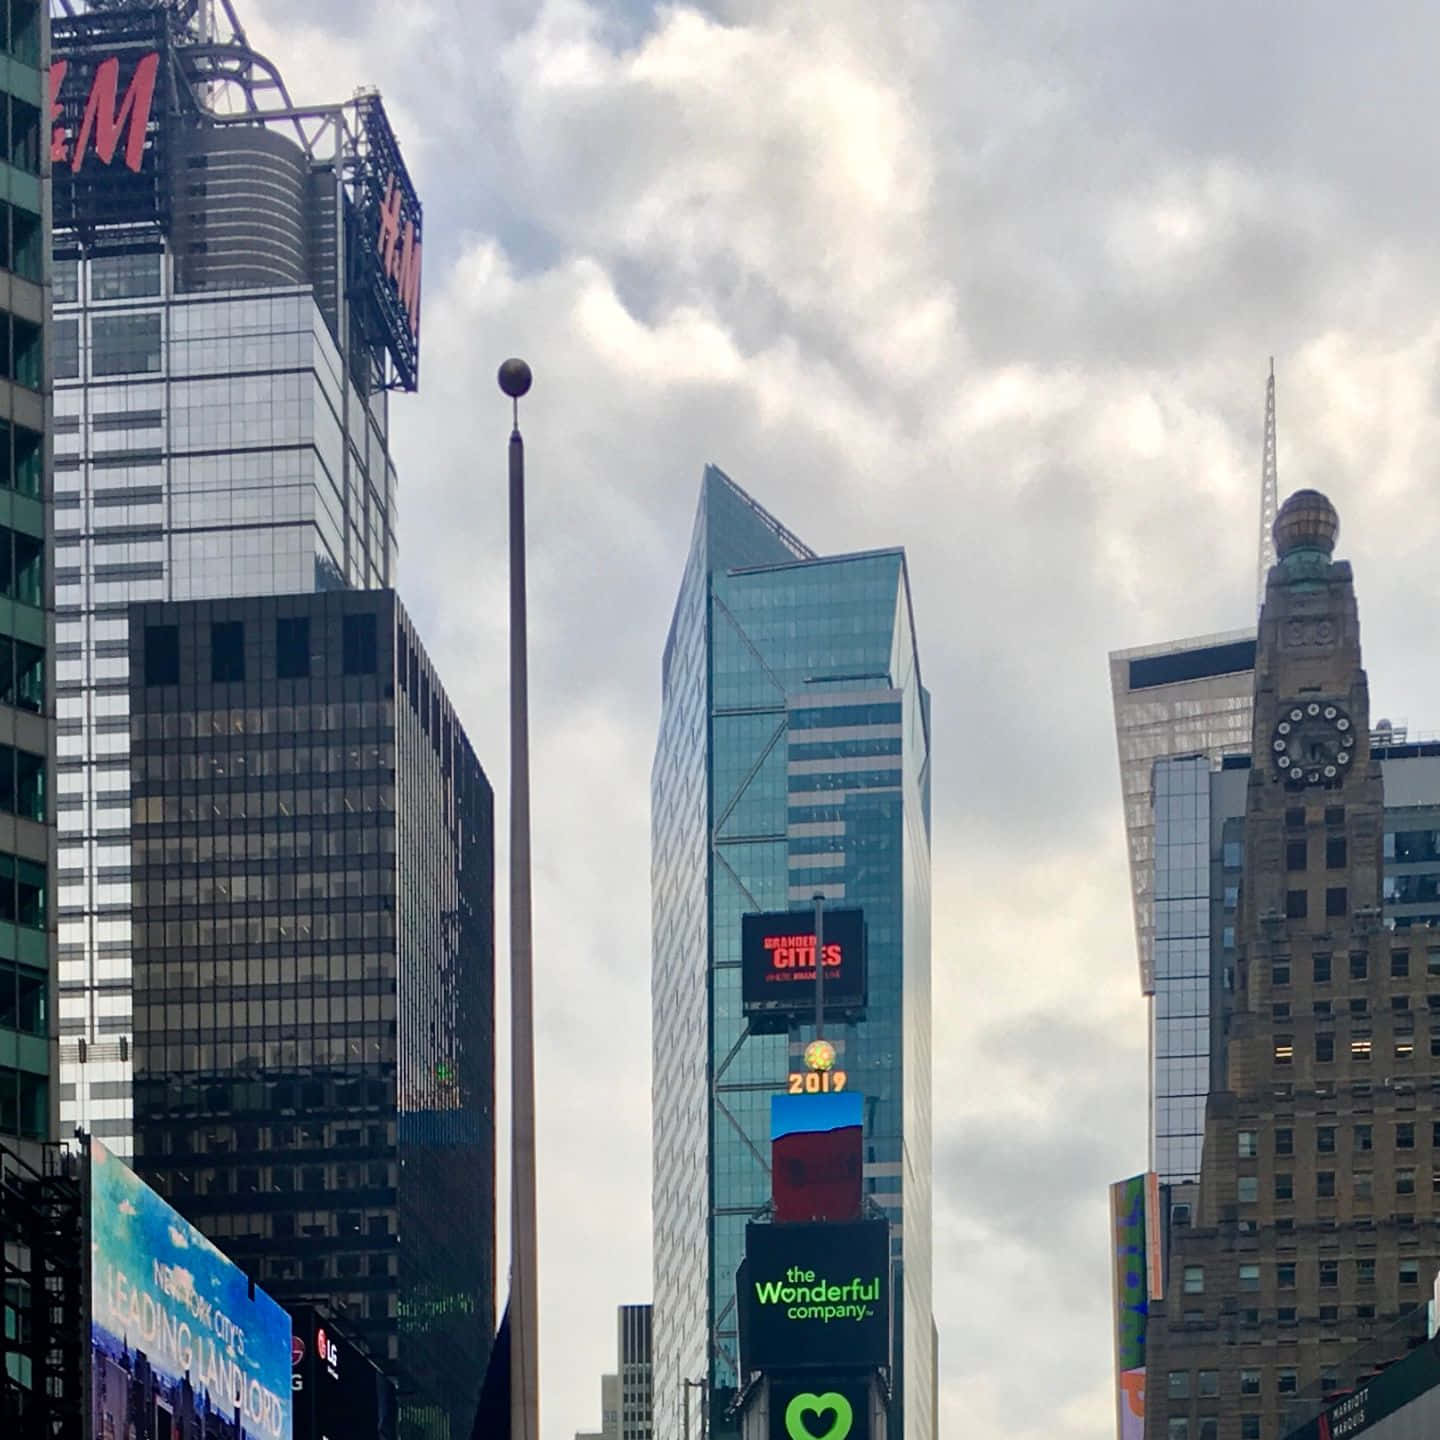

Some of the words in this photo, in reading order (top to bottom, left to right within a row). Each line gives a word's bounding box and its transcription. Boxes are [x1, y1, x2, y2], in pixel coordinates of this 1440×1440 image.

[788, 1071, 847, 1094] 2019
[786, 1266, 815, 1283] the
[755, 1277, 880, 1304] Wonderful
[787, 1304, 867, 1323] company
[106, 1263, 193, 1371] LEADING
[198, 1335, 283, 1438] LANDLORD
[1332, 1388, 1369, 1420] MARRIOTT
[1332, 1408, 1366, 1437] MARQUIS
